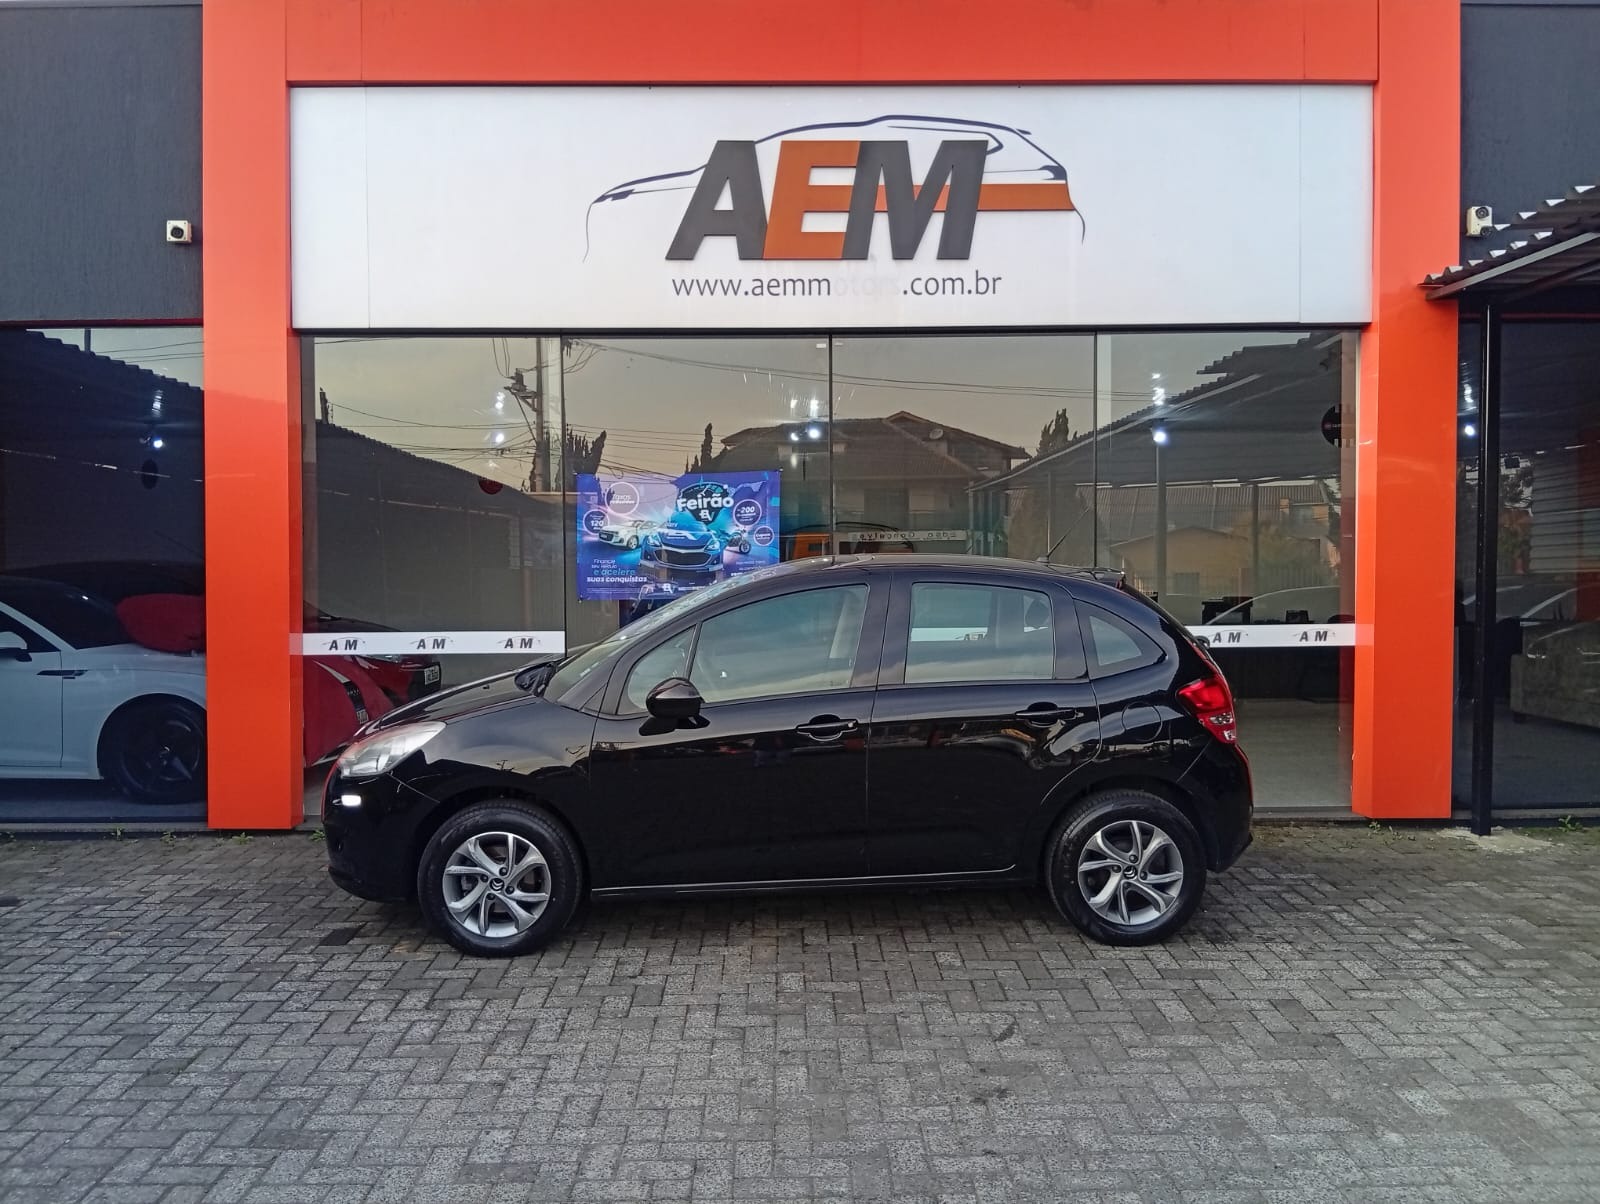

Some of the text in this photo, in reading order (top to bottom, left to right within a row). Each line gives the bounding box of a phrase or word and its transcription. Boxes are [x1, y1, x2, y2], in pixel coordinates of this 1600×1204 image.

[665, 139, 989, 261] AEM
[676, 493, 735, 512] Feirão
[606, 575, 648, 584] conquistas
